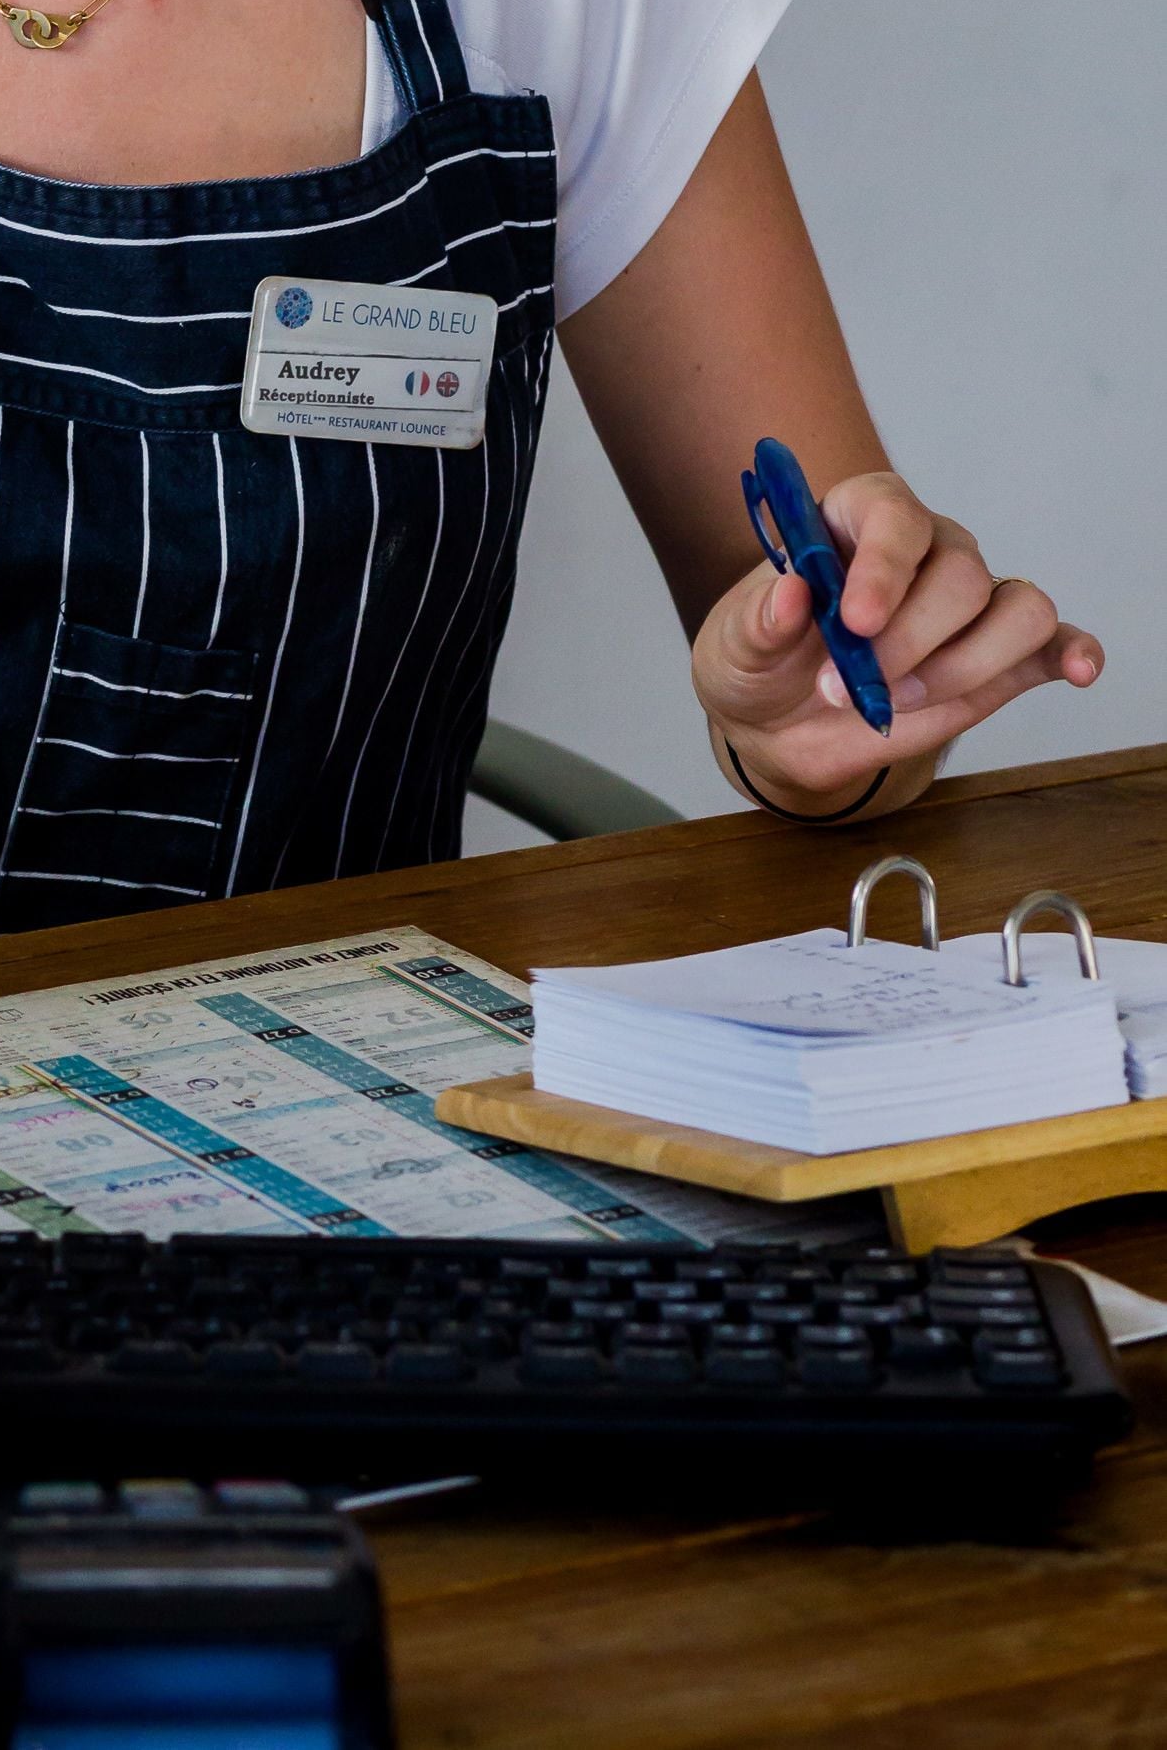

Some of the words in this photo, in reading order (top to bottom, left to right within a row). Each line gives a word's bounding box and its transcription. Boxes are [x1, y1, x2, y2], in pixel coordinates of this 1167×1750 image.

[322, 301, 345, 323] LE
[352, 303, 421, 329] GRAND
[429, 310, 477, 335] BLEU
[277, 360, 361, 386] Audrey
[259, 388, 375, 405] Réceptionniste
[328, 417, 397, 433] RESTAURANT
[400, 420, 446, 436] LOUNGE
[332, 941, 399, 960] GAGNEZ
[312, 953, 337, 965] EN
[214, 957, 312, 980] AUTONOMIE
[415, 969, 442, 979] 30
[442, 965, 457, 973] D
[171, 978, 198, 990] EN
[194, 973, 221, 985] ET
[90, 982, 172, 1005] SÉCURITÉ
[375, 1007, 436, 1026] 52
[262, 1031, 287, 1040] 27
[98, 1093, 127, 1103] 24
[366, 1088, 394, 1098] 20
[55, 1134, 115, 1152] 08
[205, 1152, 231, 1163] 17
